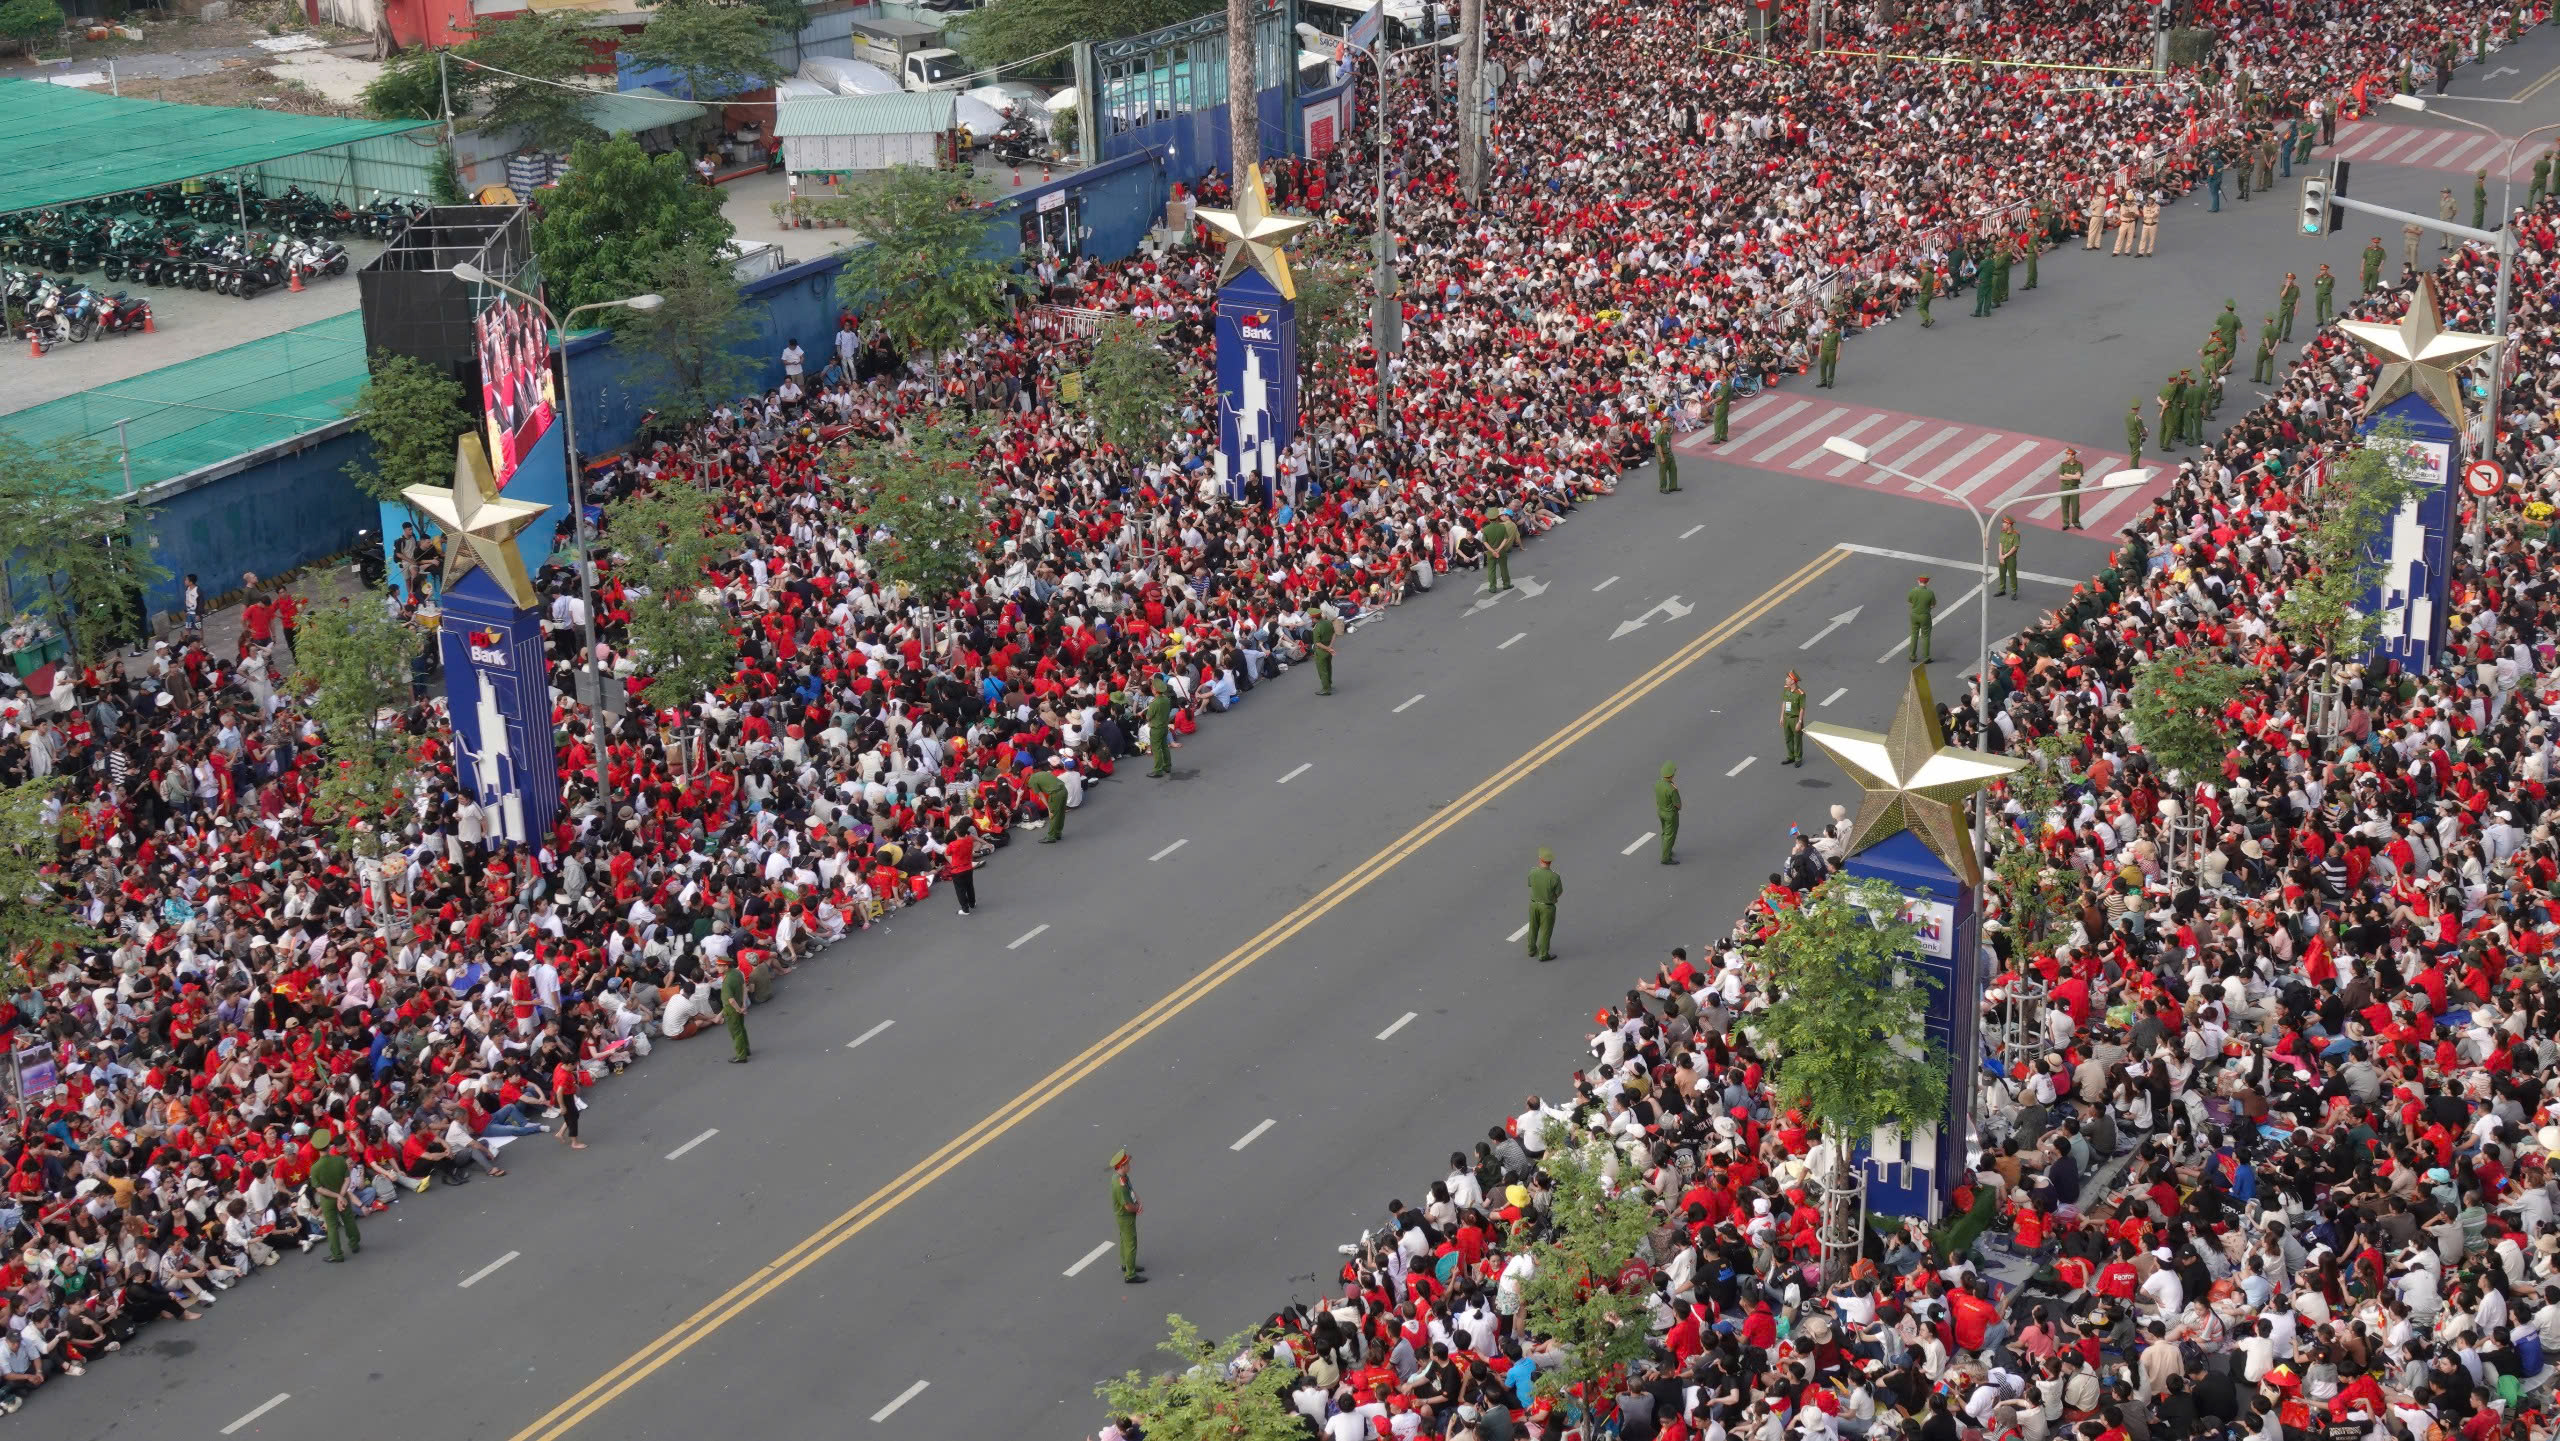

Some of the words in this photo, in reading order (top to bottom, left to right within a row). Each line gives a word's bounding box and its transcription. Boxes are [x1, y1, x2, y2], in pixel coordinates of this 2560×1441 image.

[1242, 326, 1272, 341] Bank
[469, 631, 490, 648] HD
[471, 645, 507, 666] Bank
[1919, 942, 1938, 951] ank
